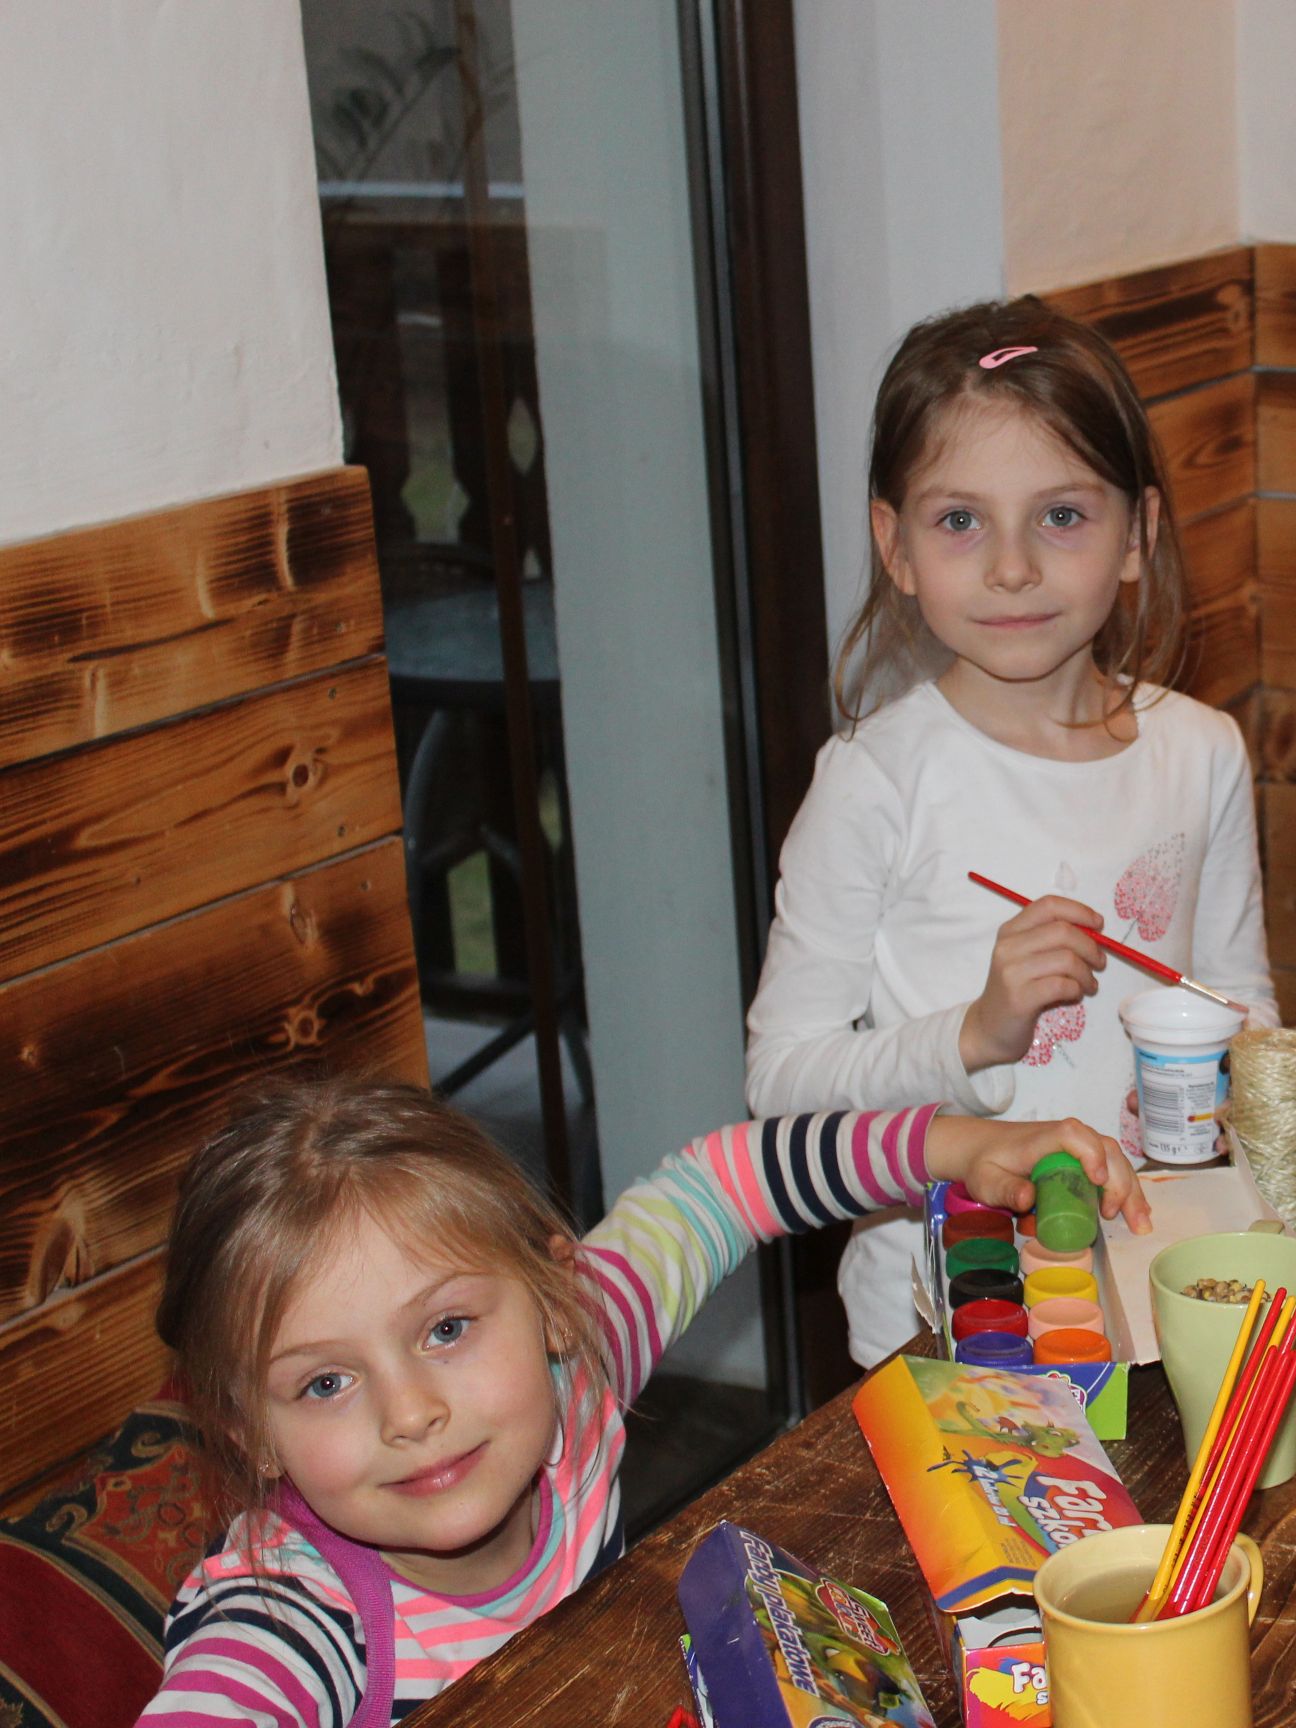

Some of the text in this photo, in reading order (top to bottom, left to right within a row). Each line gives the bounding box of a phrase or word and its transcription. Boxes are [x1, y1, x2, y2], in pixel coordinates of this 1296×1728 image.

[1018, 1496, 1085, 1550] szko
[1036, 1476, 1113, 1538] Far
[753, 1584, 821, 1698] plakatowe
[1011, 1662, 1048, 1694] Fa
